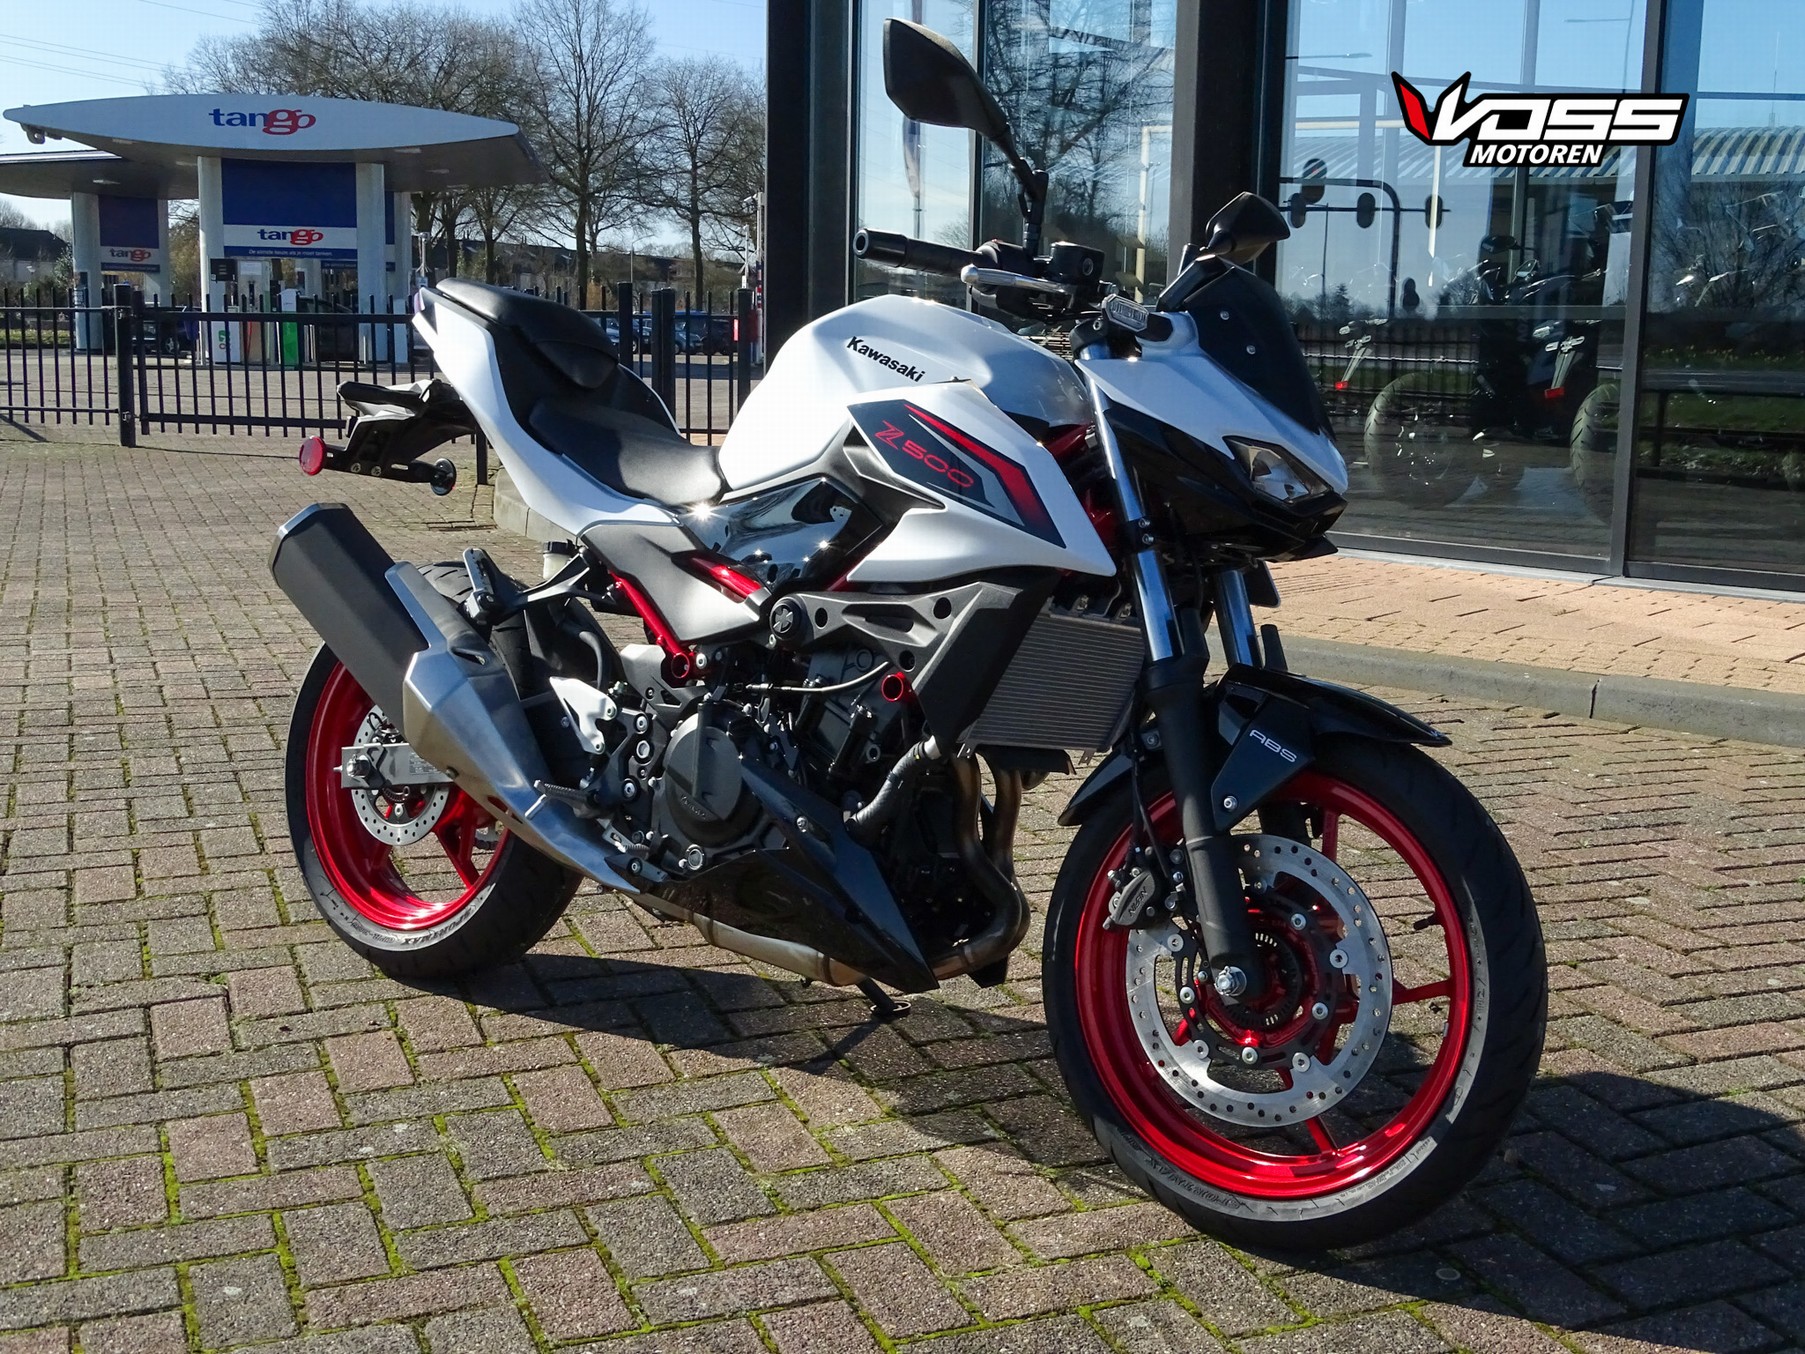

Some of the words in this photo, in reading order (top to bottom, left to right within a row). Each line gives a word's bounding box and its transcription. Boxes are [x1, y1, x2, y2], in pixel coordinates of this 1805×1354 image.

[208, 108, 317, 135] tango
[257, 228, 324, 246] tango
[109, 247, 152, 262] tango
[847, 336, 925, 382] Kawasaki
[1249, 729, 1297, 763] ABS
